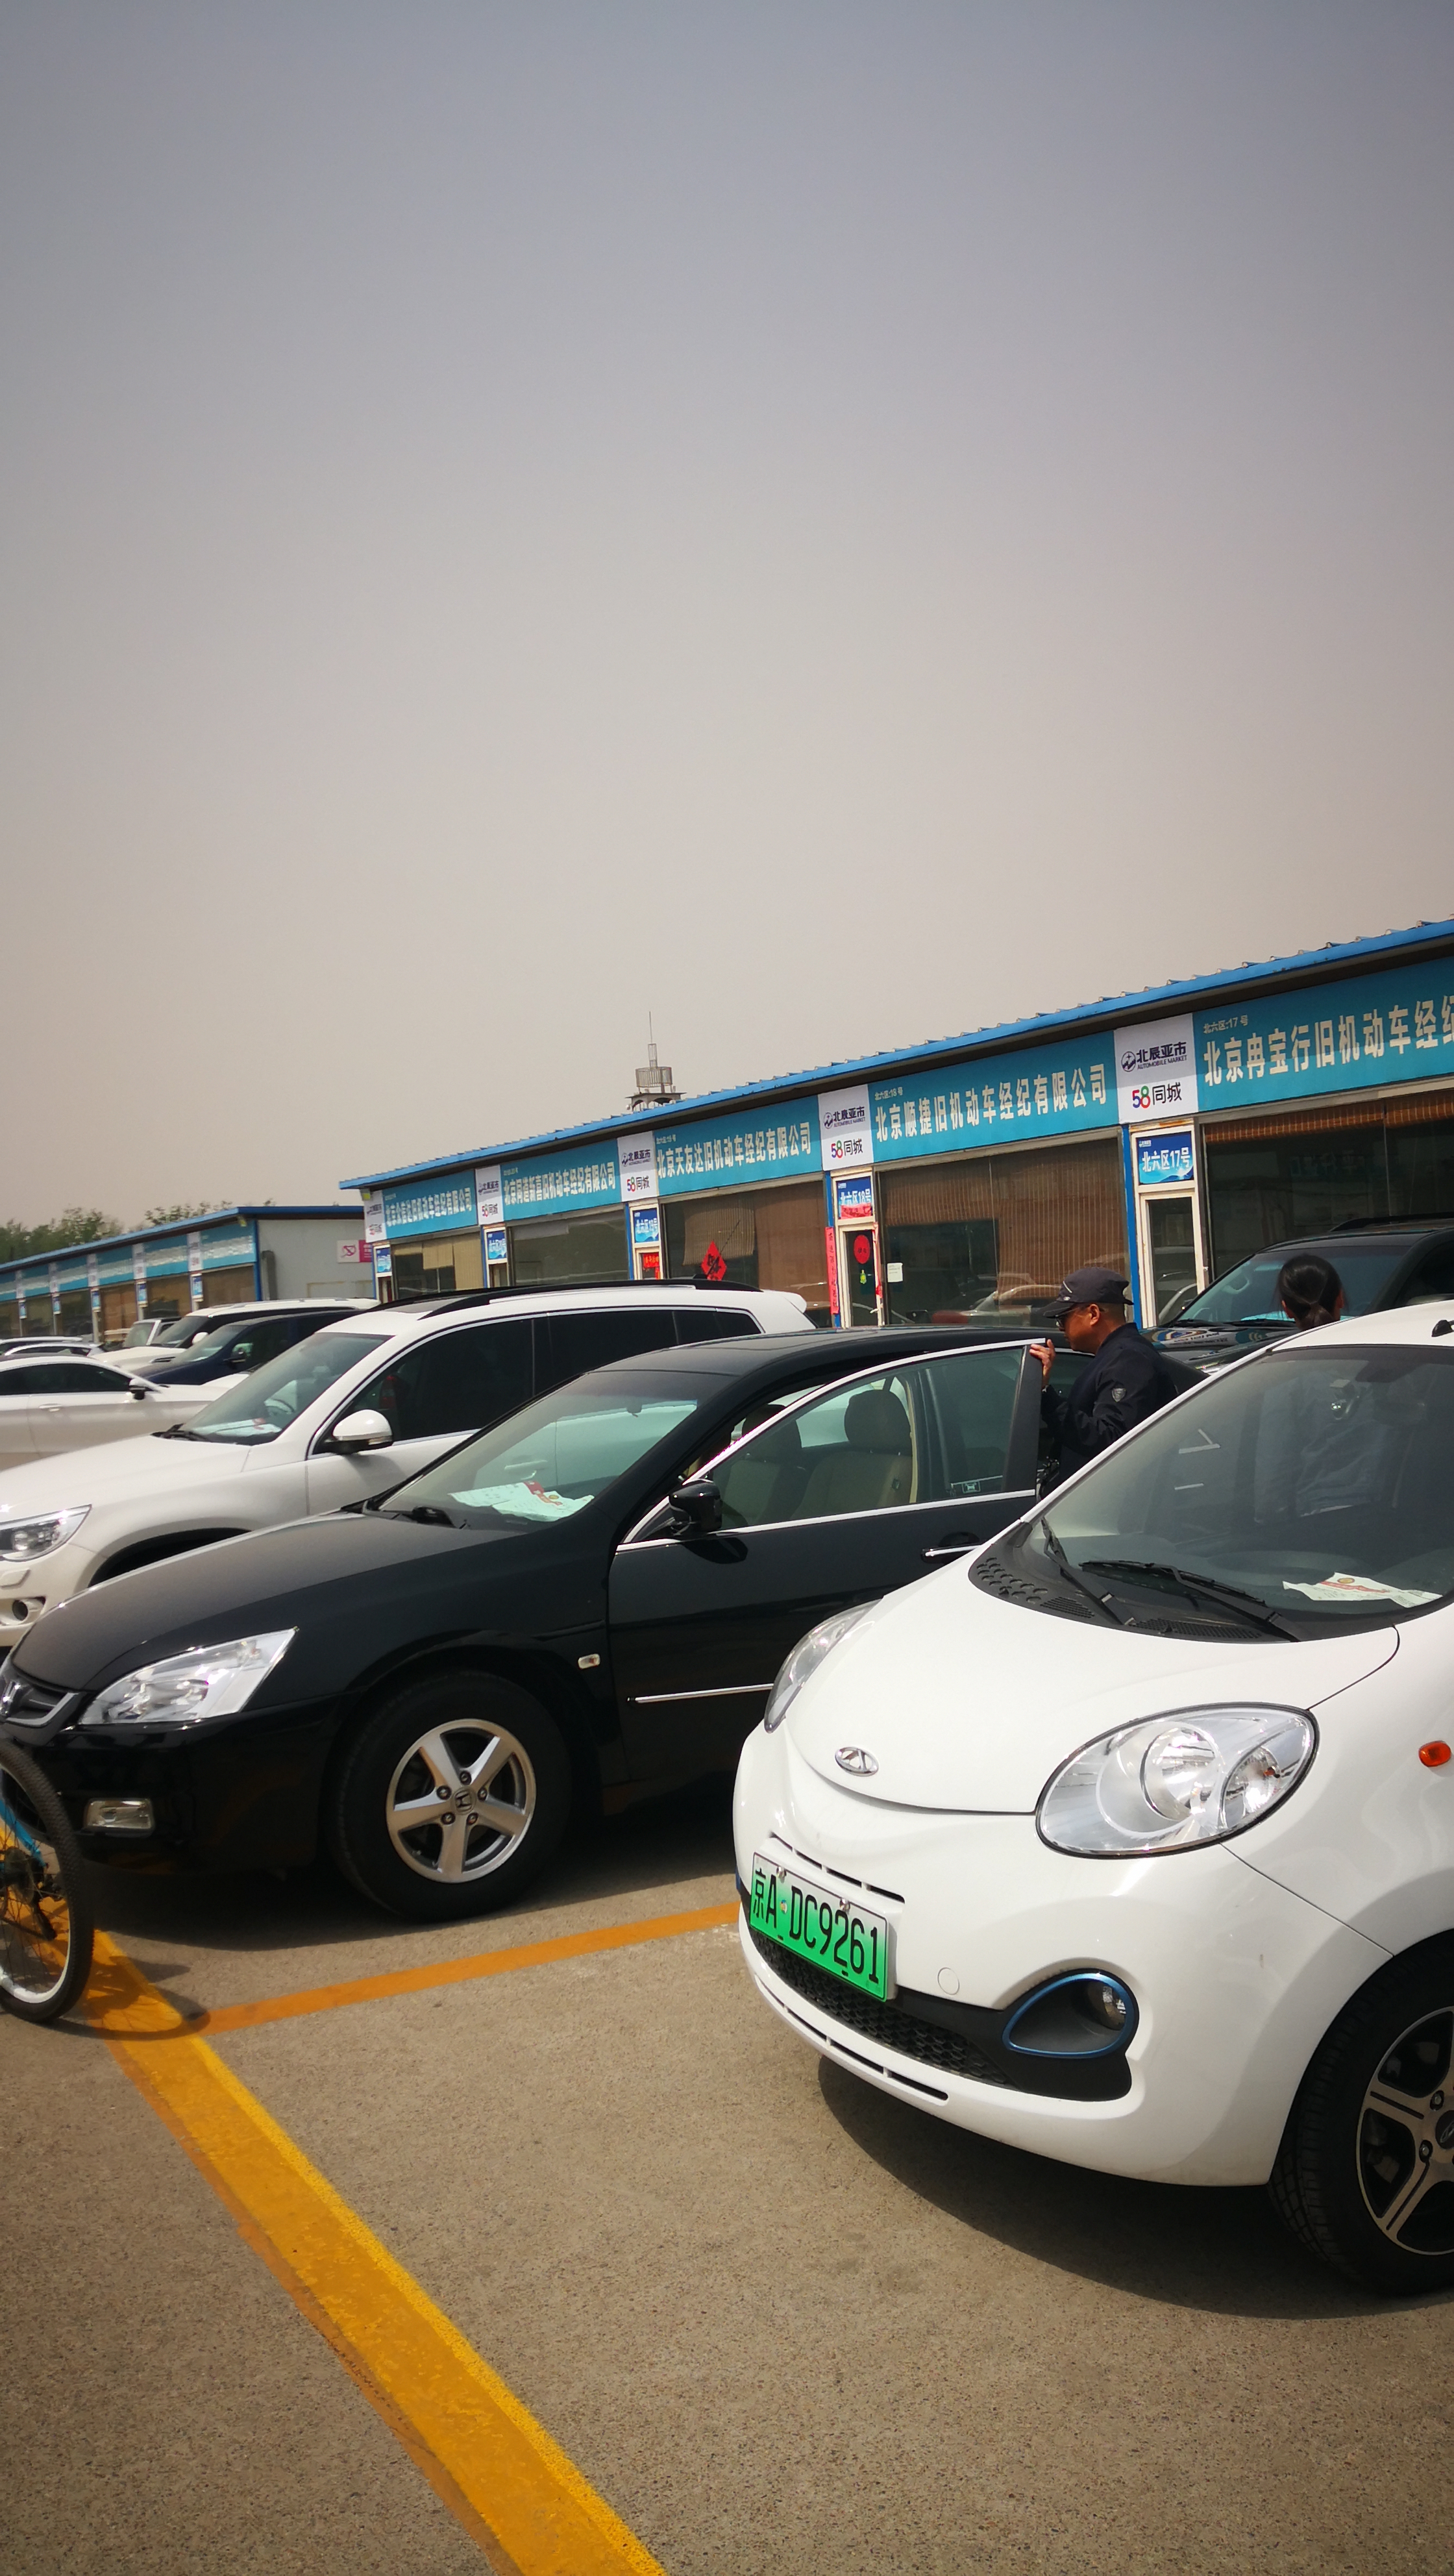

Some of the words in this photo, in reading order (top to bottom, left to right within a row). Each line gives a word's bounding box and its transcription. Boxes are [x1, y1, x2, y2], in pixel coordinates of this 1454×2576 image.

[1136, 1041, 1187, 1063] 北辰亚市
[1137, 1059, 1166, 1070] AUTOMOBILE
[1168, 1054, 1187, 1063] MARKET
[875, 1063, 1107, 1143] 北京顺捷旧机动车经纪有限公司
[1132, 1082, 1182, 1109] 58同城
[833, 1106, 865, 1122] 北辰亚市
[831, 1138, 863, 1159] 58同城
[1141, 1146, 1191, 1172] 北六区17号
[626, 1175, 650, 1193] 58同城
